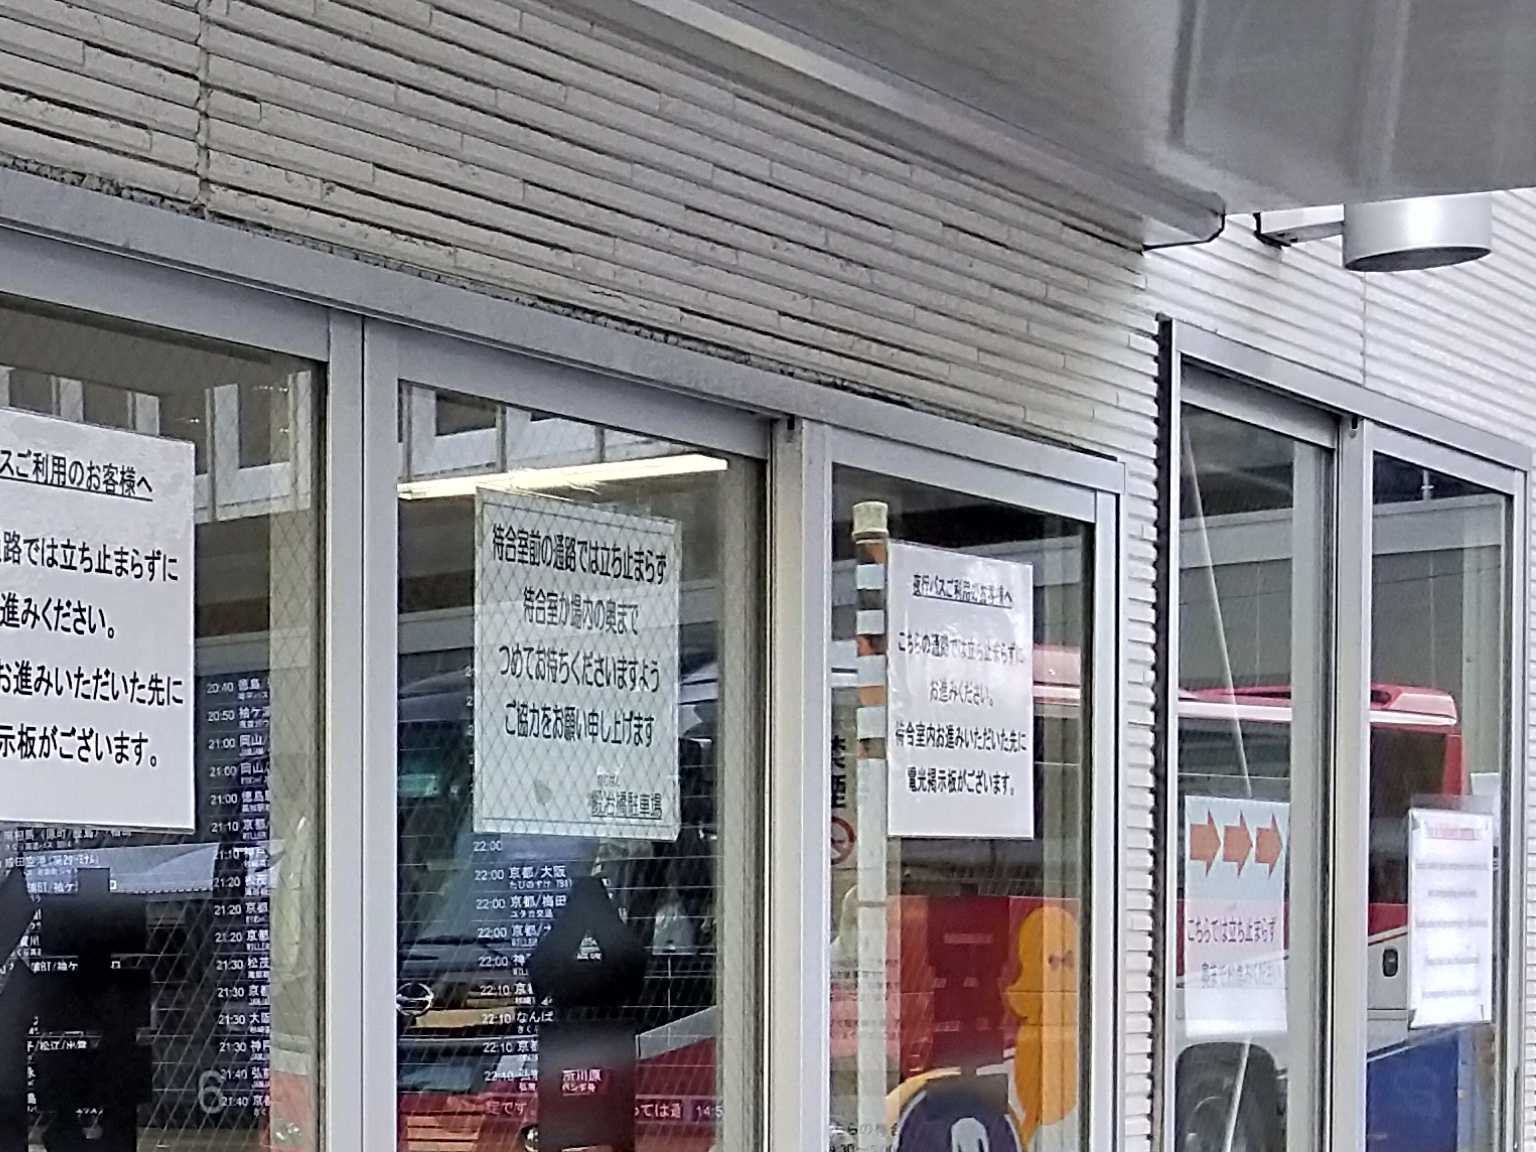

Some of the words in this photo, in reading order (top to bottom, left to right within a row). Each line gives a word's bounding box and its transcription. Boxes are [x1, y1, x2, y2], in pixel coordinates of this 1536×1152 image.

[492, 523, 667, 585] 待合室前の通路では立ち止まらず
[499, 644, 660, 693] つめてお待ちくださいますよう
[505, 699, 655, 748] ご協力をお願い申し上げます
[472, 840, 503, 851] 22:00
[475, 870, 505, 881] 22:00
[508, 865, 567, 879] 京都/大阪
[476, 898, 506, 910] 22:00
[477, 927, 507, 938] 22:00
[478, 956, 509, 967] 22:00
[480, 985, 510, 996] 22:10
[483, 1042, 513, 1053] 22:10
